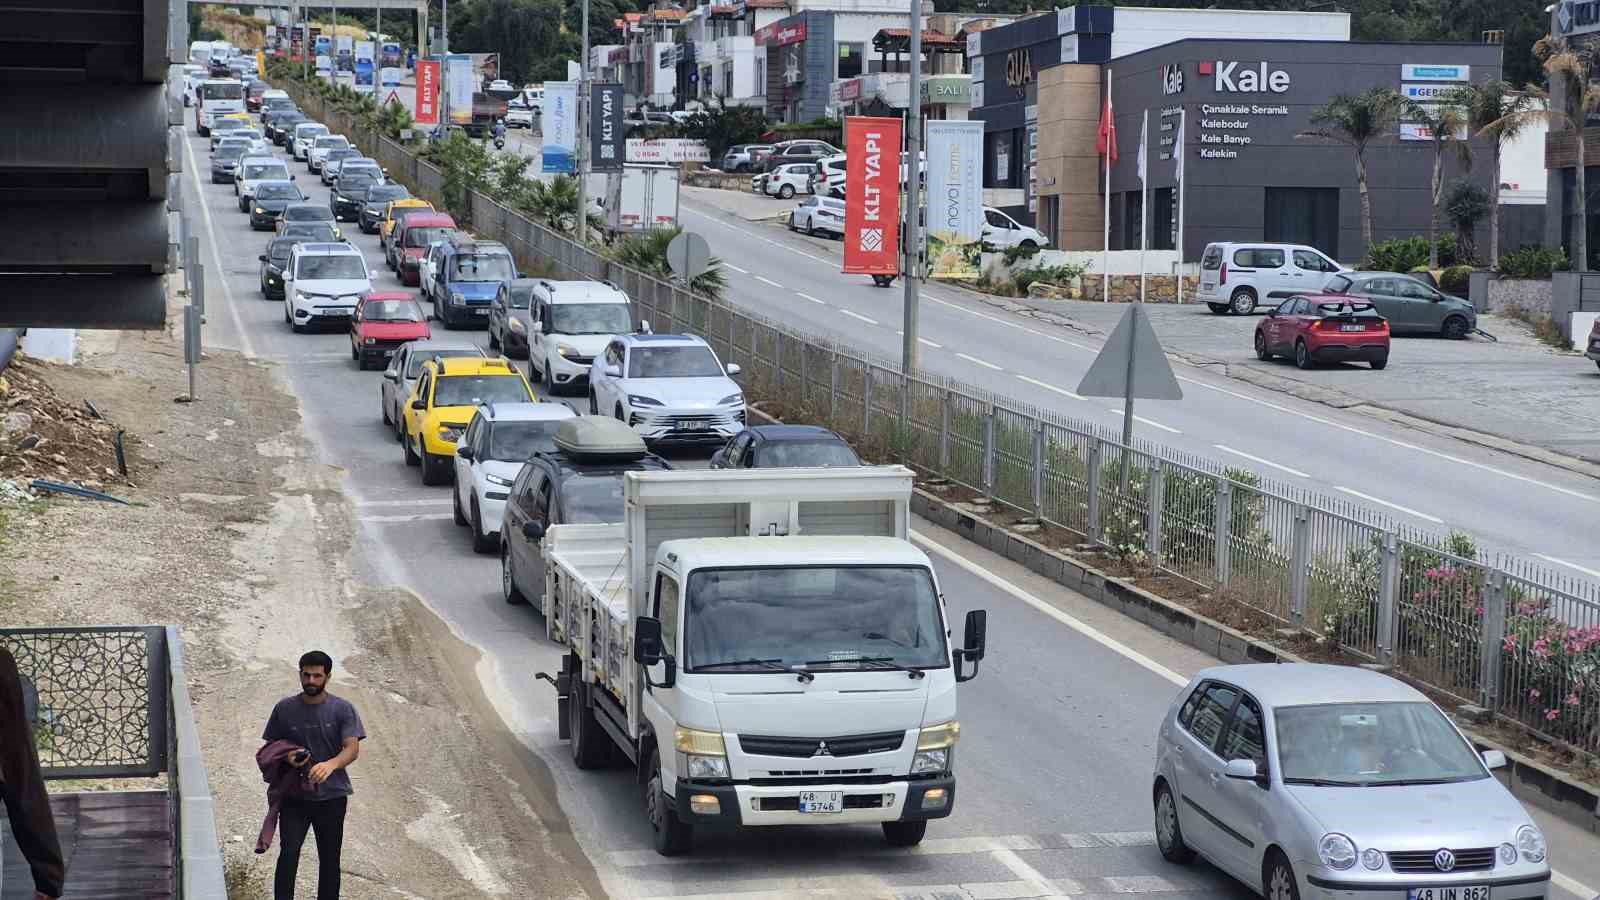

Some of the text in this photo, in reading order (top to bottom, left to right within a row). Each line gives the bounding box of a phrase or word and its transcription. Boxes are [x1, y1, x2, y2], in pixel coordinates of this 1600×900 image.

[1006, 48, 1032, 88] QUA
[1163, 63, 1183, 95] Kale
[1215, 60, 1290, 92] Kale
[602, 90, 613, 141] KLT YAPI
[1202, 104, 1289, 115] Çanakkale Seramik
[1201, 119, 1249, 129] Kalebodur
[1201, 134, 1251, 145] Kale Banyo
[1200, 149, 1237, 158] Kalekim
[864, 133, 881, 221] KLT YAPI
[1416, 887, 1488, 900] 48 UN 862
